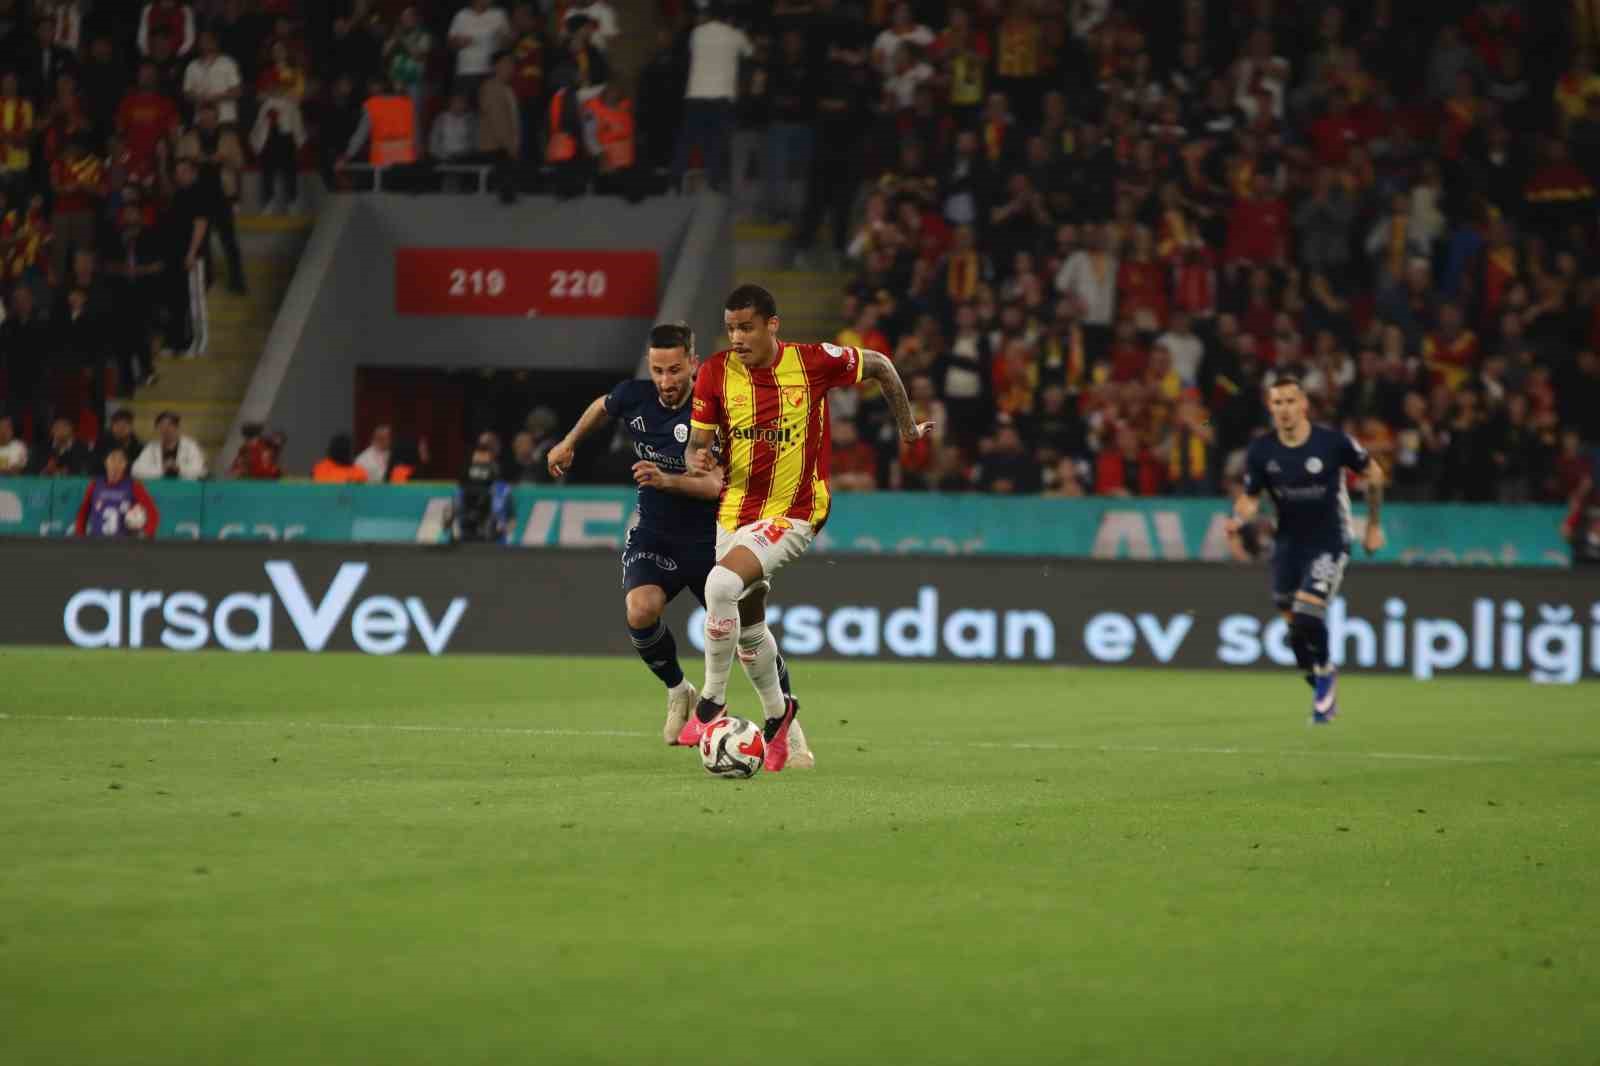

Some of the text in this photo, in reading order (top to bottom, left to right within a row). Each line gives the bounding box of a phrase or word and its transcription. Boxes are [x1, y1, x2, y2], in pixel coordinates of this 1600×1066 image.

[449, 268, 607, 298] 219 220
[733, 427, 792, 442] euroil
[63, 560, 468, 656] arsaVev
[1083, 611, 1195, 663] ev
